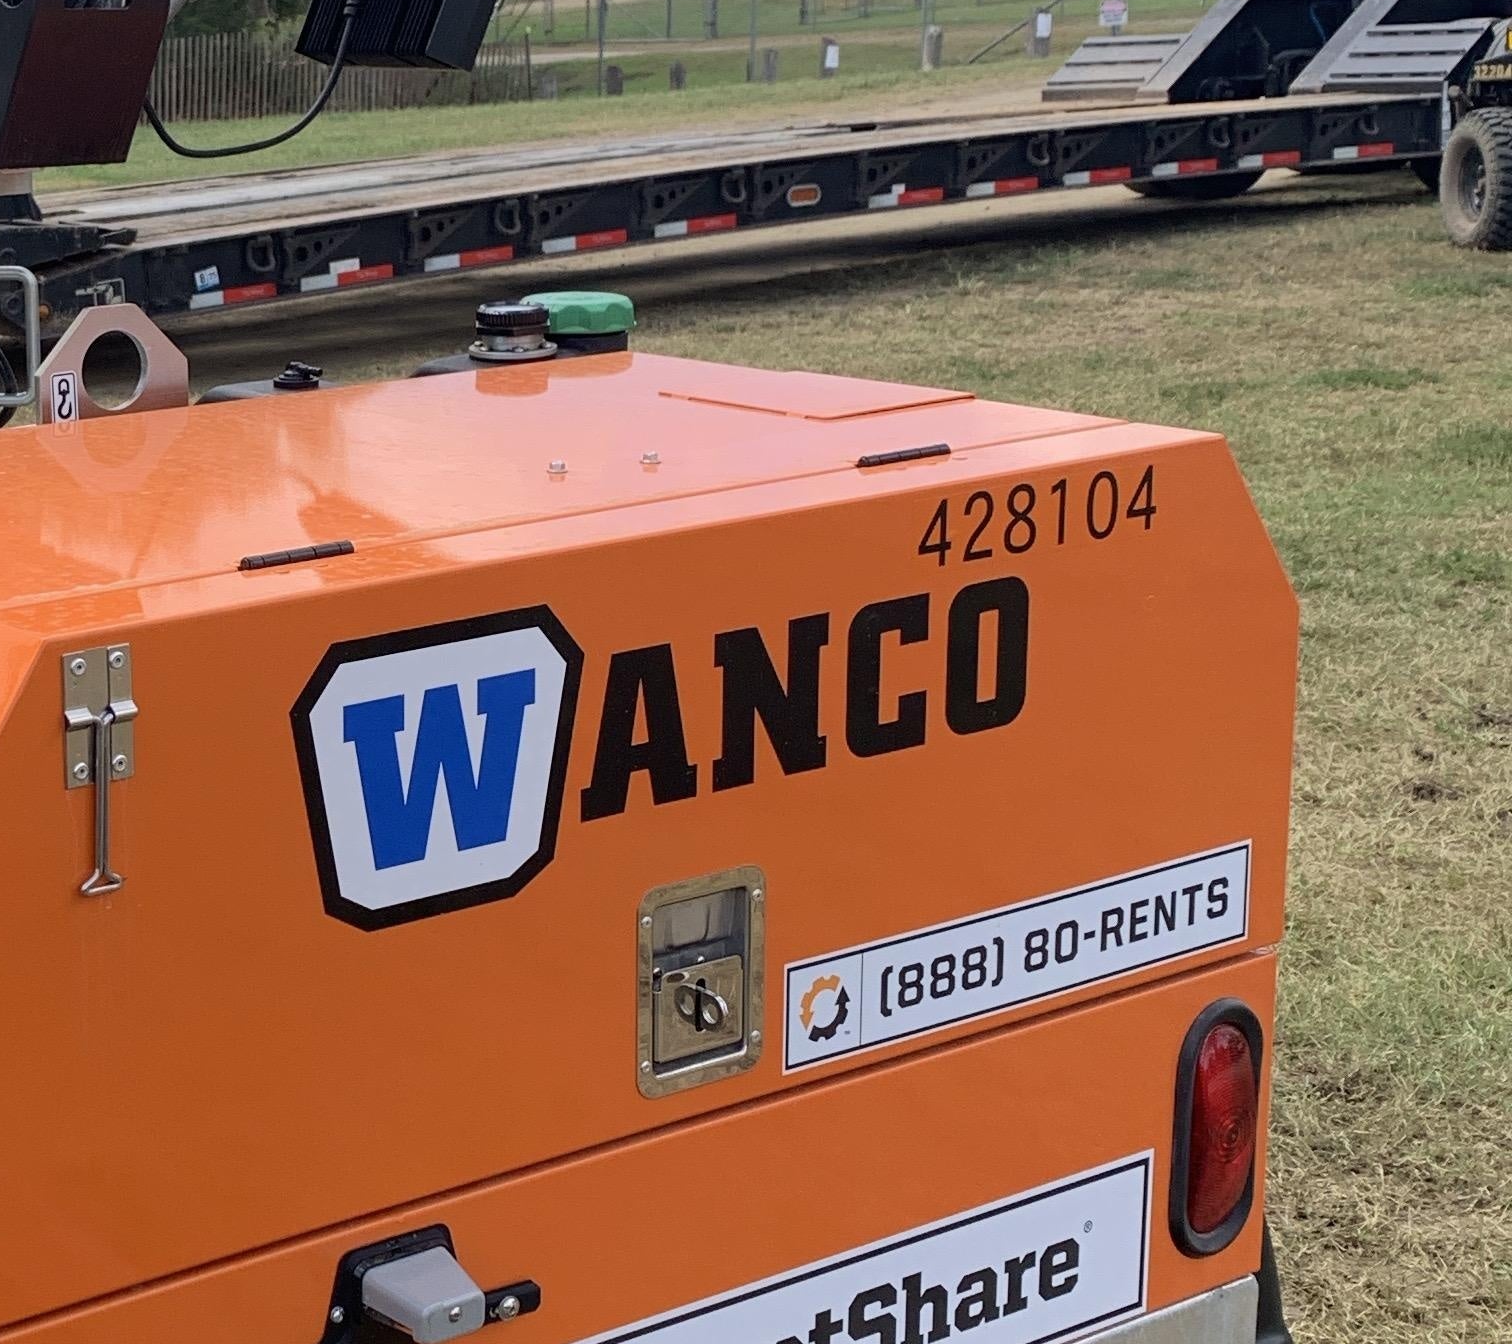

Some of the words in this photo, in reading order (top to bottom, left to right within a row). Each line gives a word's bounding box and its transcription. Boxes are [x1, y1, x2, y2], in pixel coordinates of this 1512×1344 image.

[918, 464, 1157, 567] 428104
[343, 576, 1029, 870] WANCO
[880, 936, 1004, 1018] (888)
[1025, 876, 1231, 972] 80-RENTS
